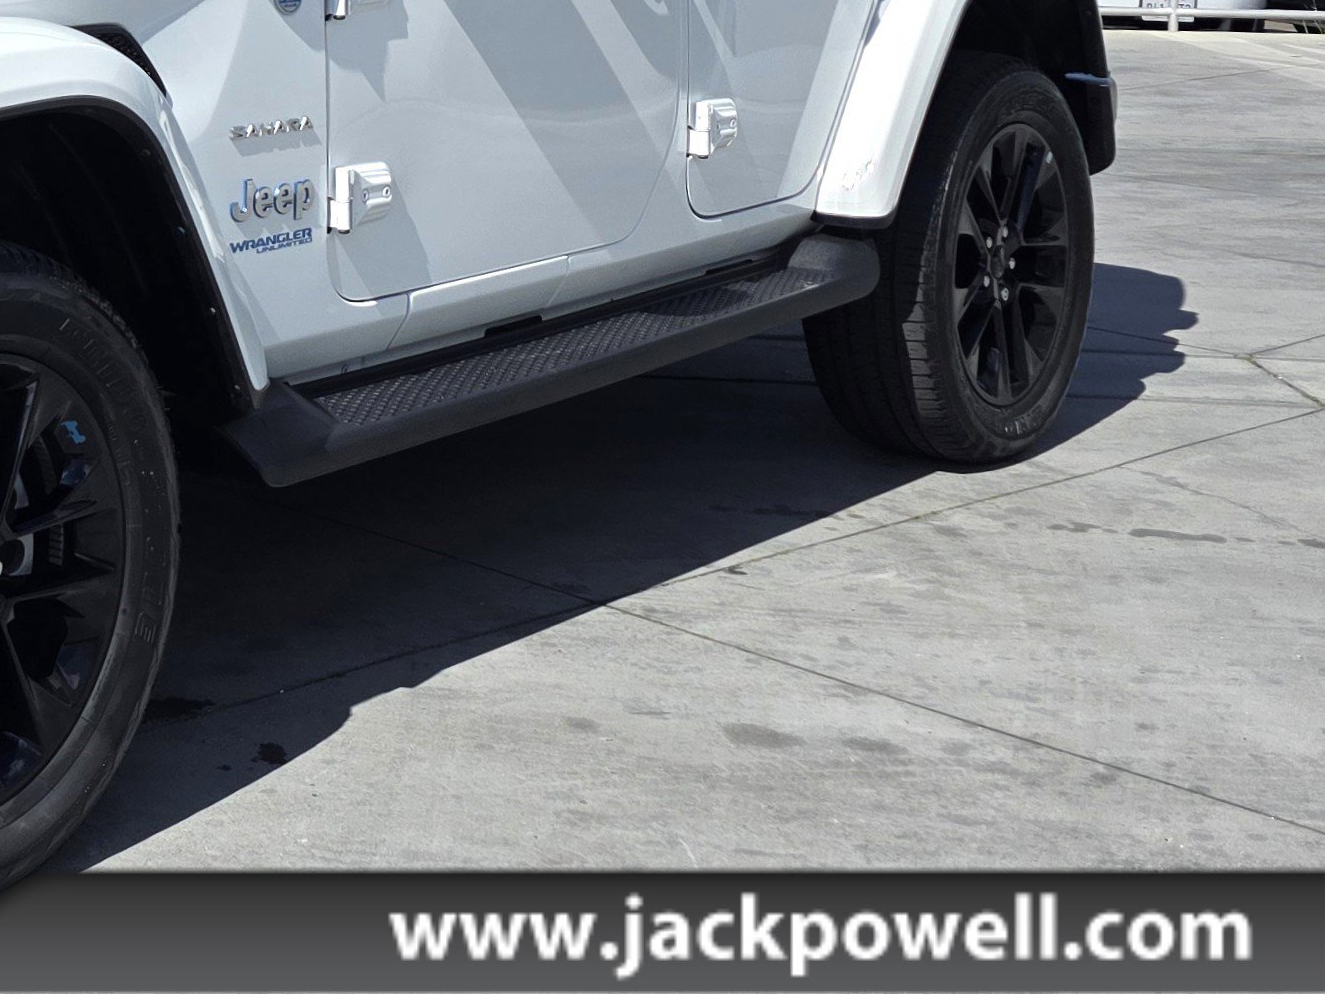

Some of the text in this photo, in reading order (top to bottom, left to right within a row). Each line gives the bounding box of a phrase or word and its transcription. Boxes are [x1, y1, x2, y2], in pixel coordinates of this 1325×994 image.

[230, 116, 313, 139] SAHARA
[230, 178, 315, 223] Jeep
[230, 227, 312, 254] WRANGLER
[256, 236, 313, 254] UNLIMITED
